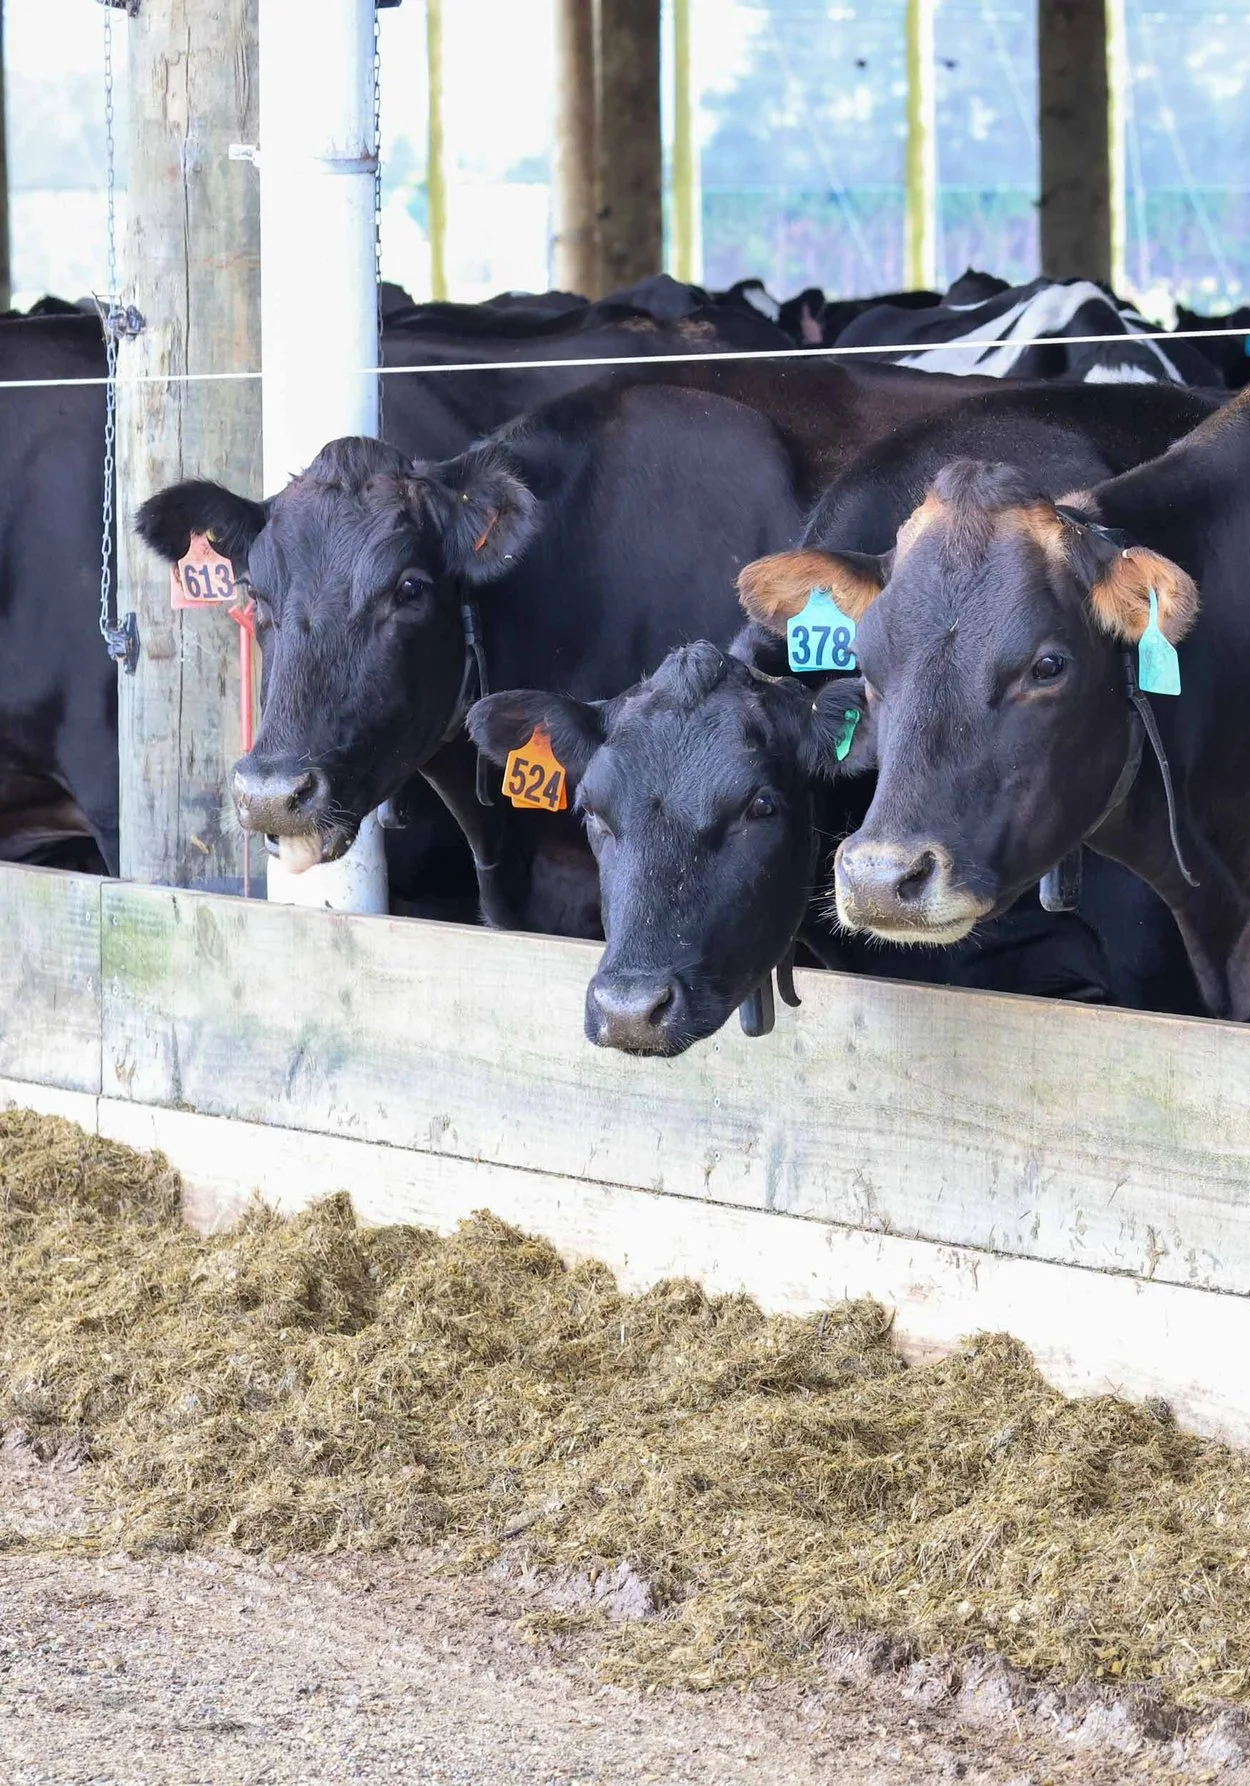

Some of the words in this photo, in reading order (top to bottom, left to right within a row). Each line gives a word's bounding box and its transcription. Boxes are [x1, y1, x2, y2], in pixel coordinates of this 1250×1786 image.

[184, 564, 233, 598] 613
[792, 625, 851, 667] 378
[508, 757, 561, 808] 524
